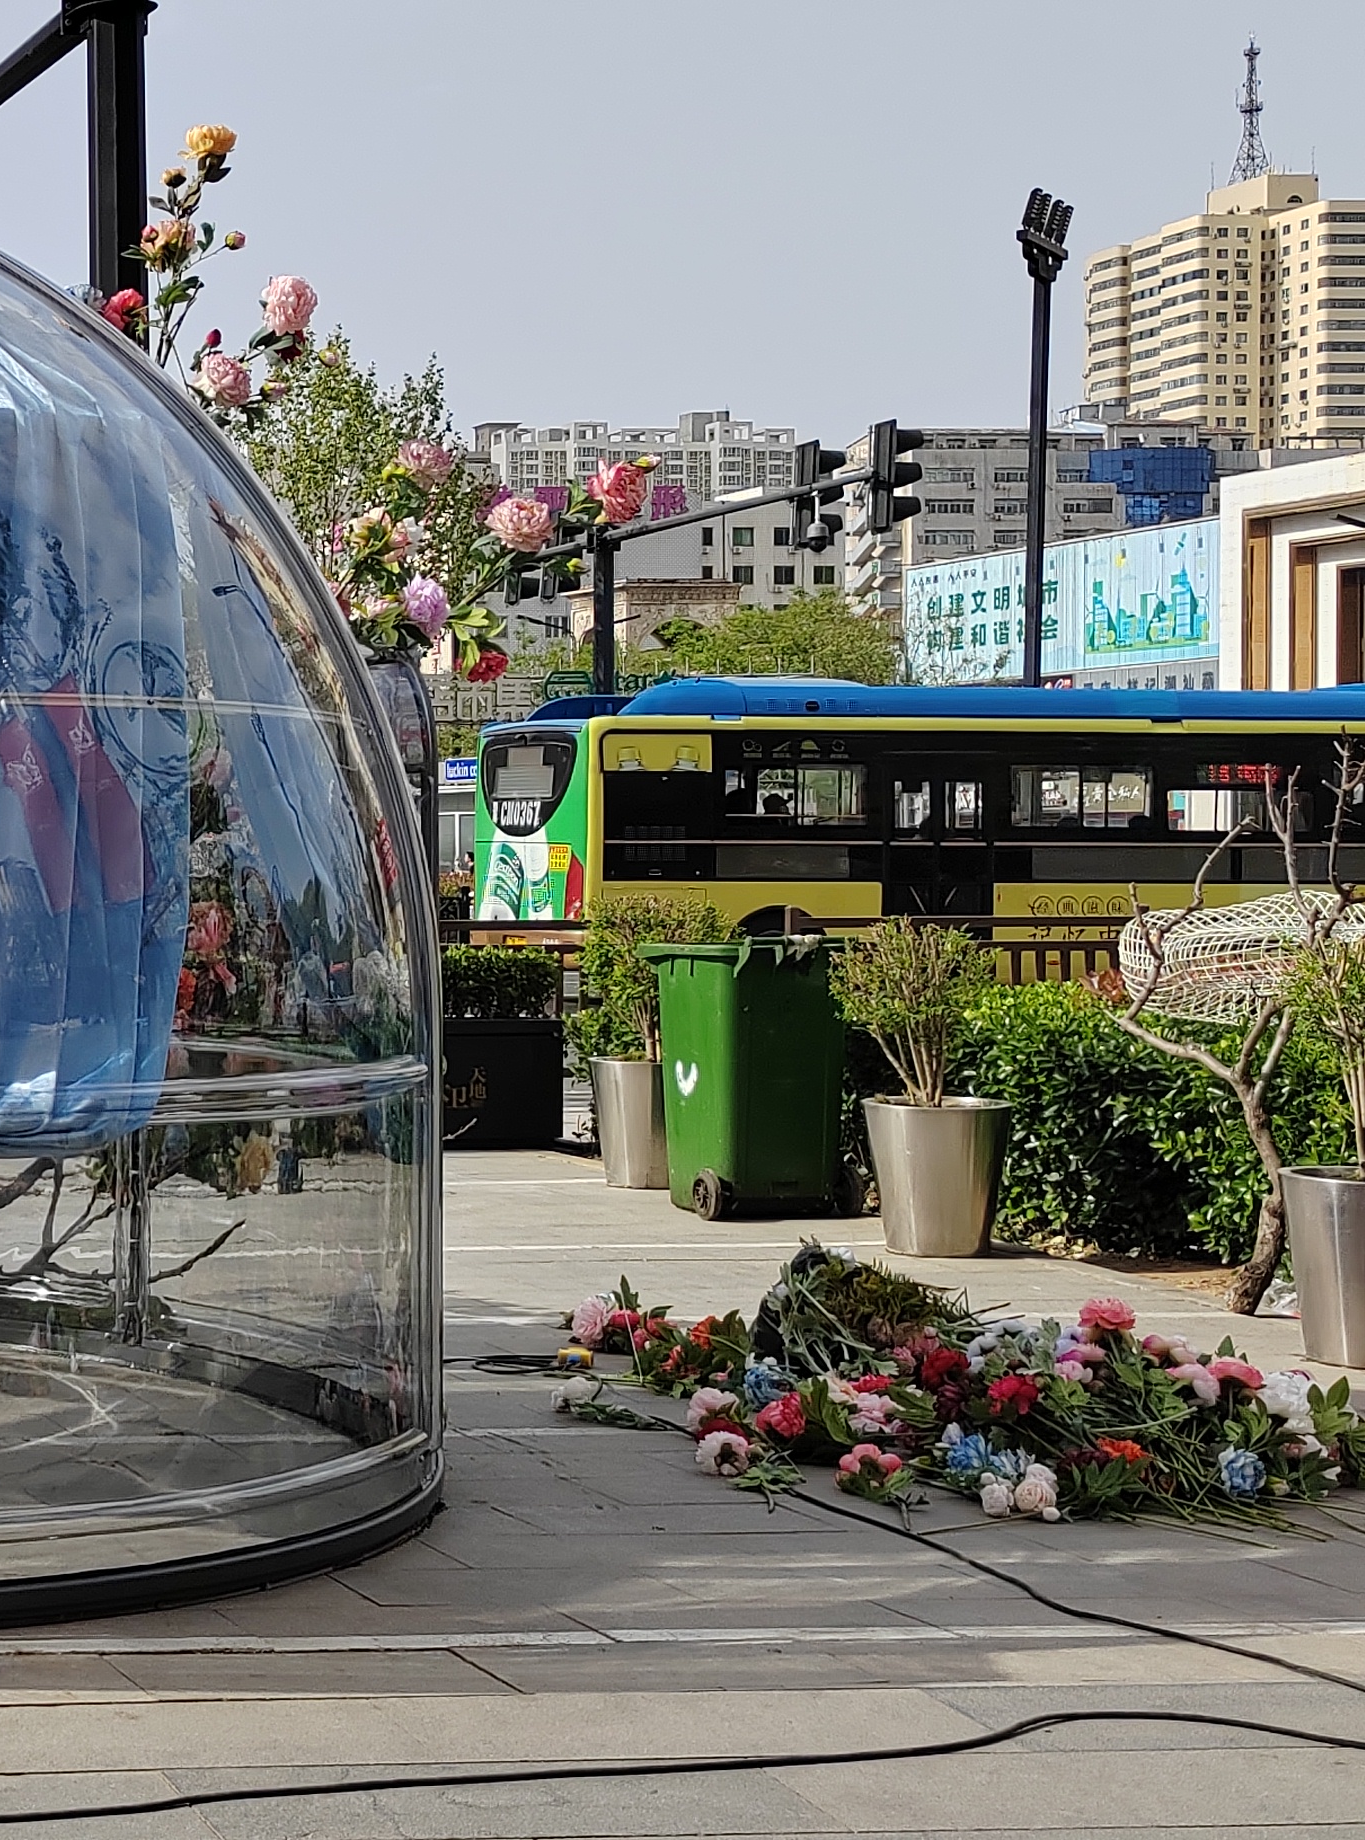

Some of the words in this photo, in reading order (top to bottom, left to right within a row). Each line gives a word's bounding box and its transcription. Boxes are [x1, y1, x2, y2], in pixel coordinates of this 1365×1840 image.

[926, 579, 1059, 620] 创建文明市
[926, 615, 1059, 652] 构建和谐会
